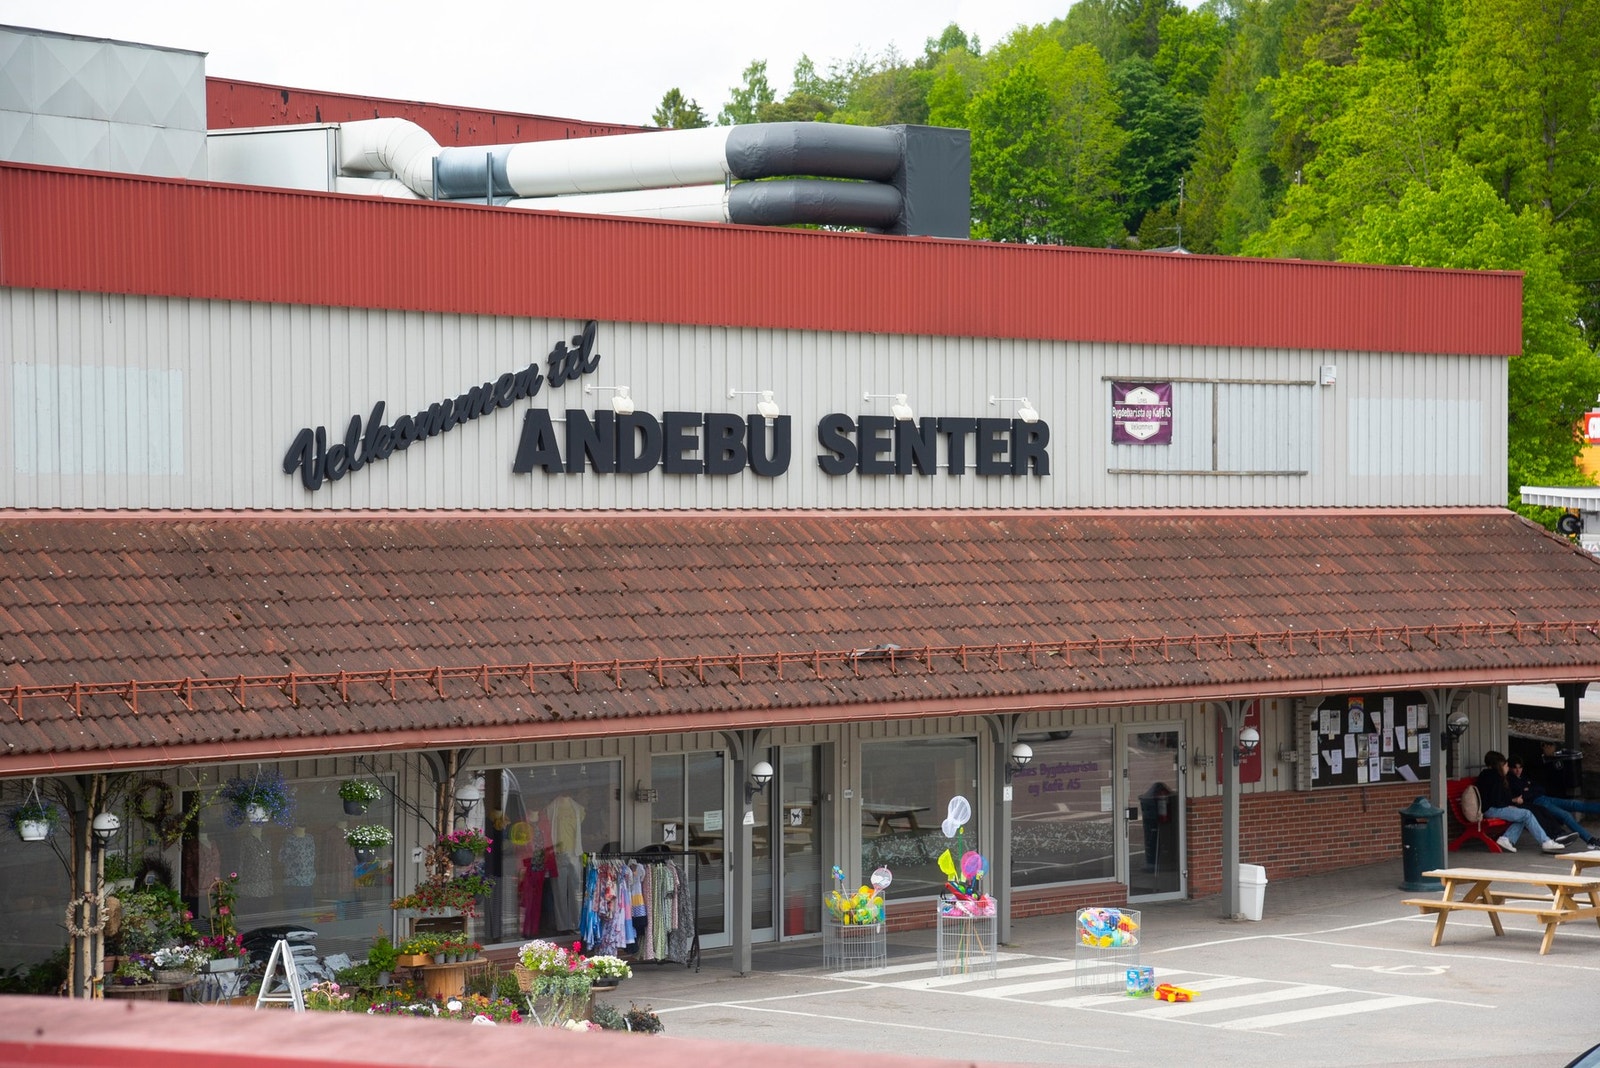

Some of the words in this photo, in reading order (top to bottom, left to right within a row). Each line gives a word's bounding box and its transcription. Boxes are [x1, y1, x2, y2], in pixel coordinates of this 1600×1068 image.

[283, 363, 544, 490] Velkommen
[547, 320, 601, 388] til
[1146, 411, 1152, 419] og
[513, 408, 791, 478] ANDEBU
[817, 413, 1051, 477] SENTER
[1028, 785, 1040, 797] og
[1067, 778, 1081, 790] AS
